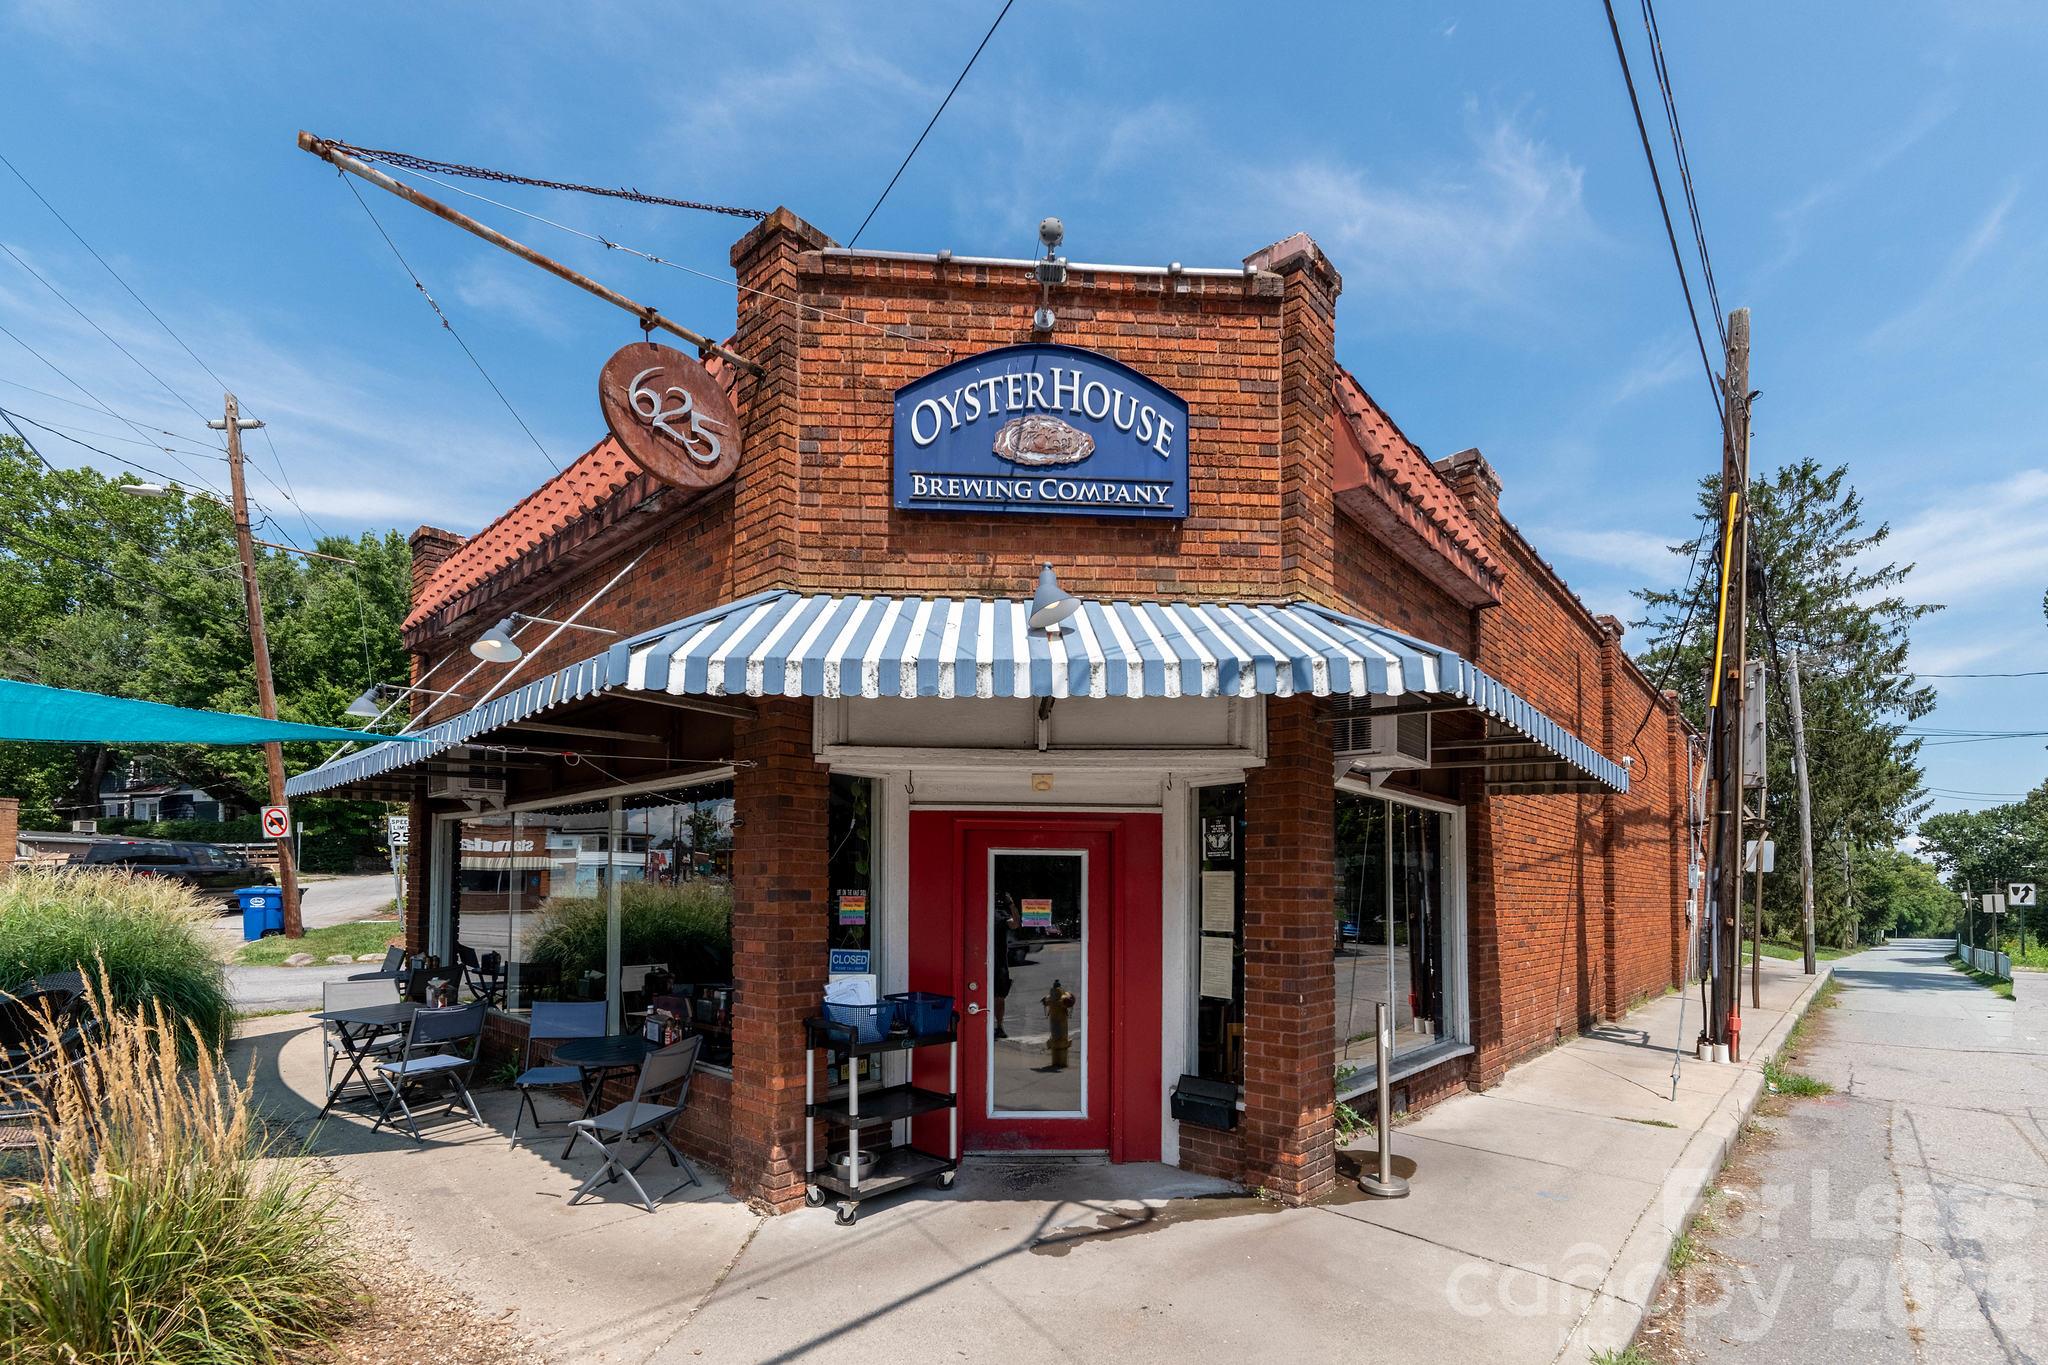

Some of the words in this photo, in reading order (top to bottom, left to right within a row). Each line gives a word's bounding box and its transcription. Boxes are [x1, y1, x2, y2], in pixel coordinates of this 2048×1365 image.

[629, 366, 729, 462] 625
[910, 367, 1175, 458] OYSTERHOUSE
[912, 474, 1033, 500] BREWING
[1039, 478, 1170, 504] COMPANY
[392, 831, 409, 842] 25
[832, 954, 868, 965] CLOSED
